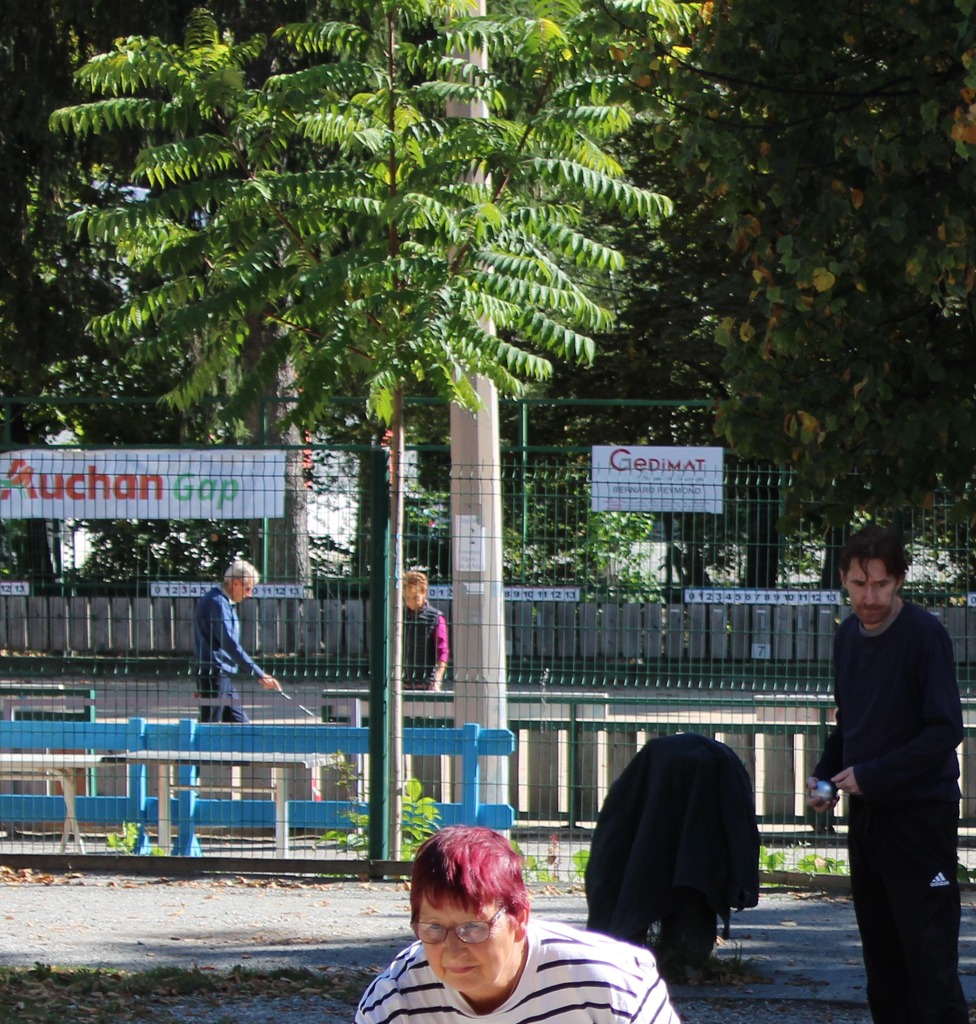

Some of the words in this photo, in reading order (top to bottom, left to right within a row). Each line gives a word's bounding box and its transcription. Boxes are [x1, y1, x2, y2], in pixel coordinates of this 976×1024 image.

[0, 458, 163, 500] Auchan
[173, 473, 239, 510] Gap
[613, 485, 655, 494] BERNARD
[657, 486, 701, 495] REYMOND
[15, 585, 25, 593] 13
[757, 645, 766, 656] 7
